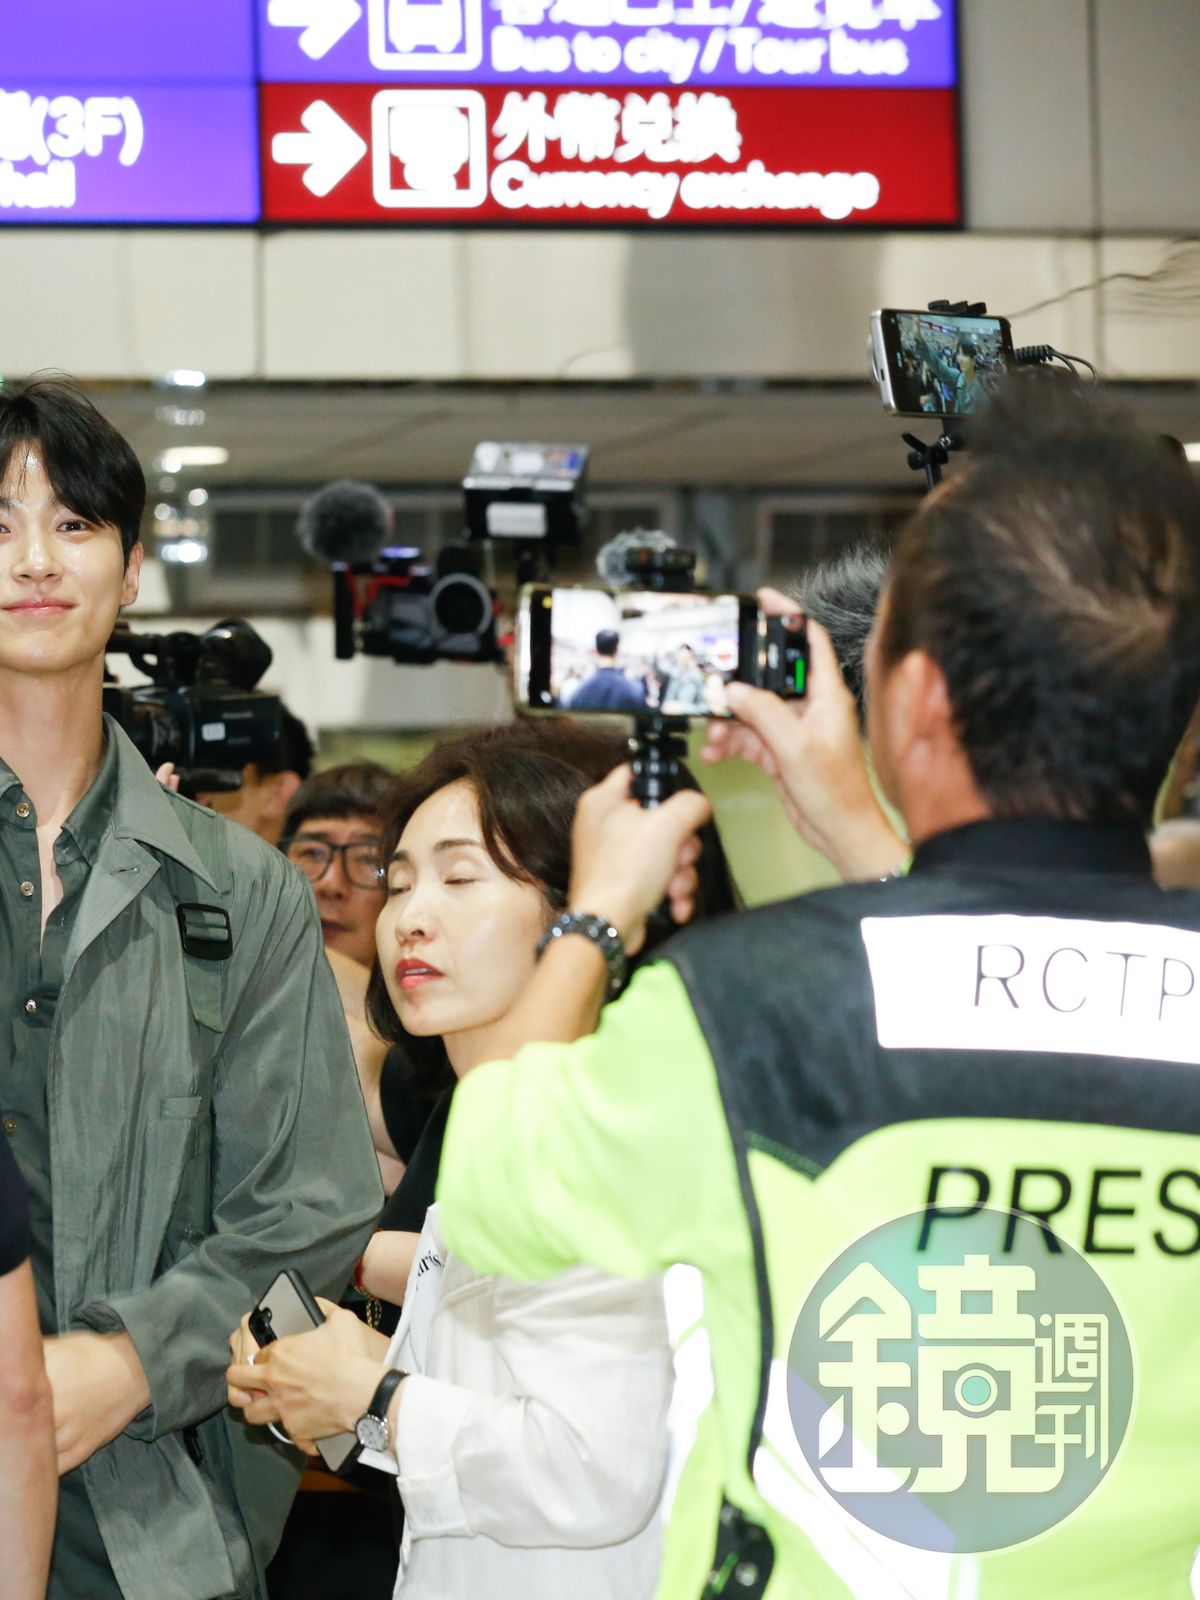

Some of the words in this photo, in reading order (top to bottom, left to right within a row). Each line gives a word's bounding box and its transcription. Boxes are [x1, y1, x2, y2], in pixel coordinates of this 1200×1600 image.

[492, 26, 569, 70] Bus
[574, 33, 620, 71] to
[830, 29, 906, 73] bus
[491, 160, 679, 218] Currency
[681, 161, 879, 219] exchange
[974, 943, 1196, 1021] RCTP
[915, 1165, 1200, 1258] PRES
